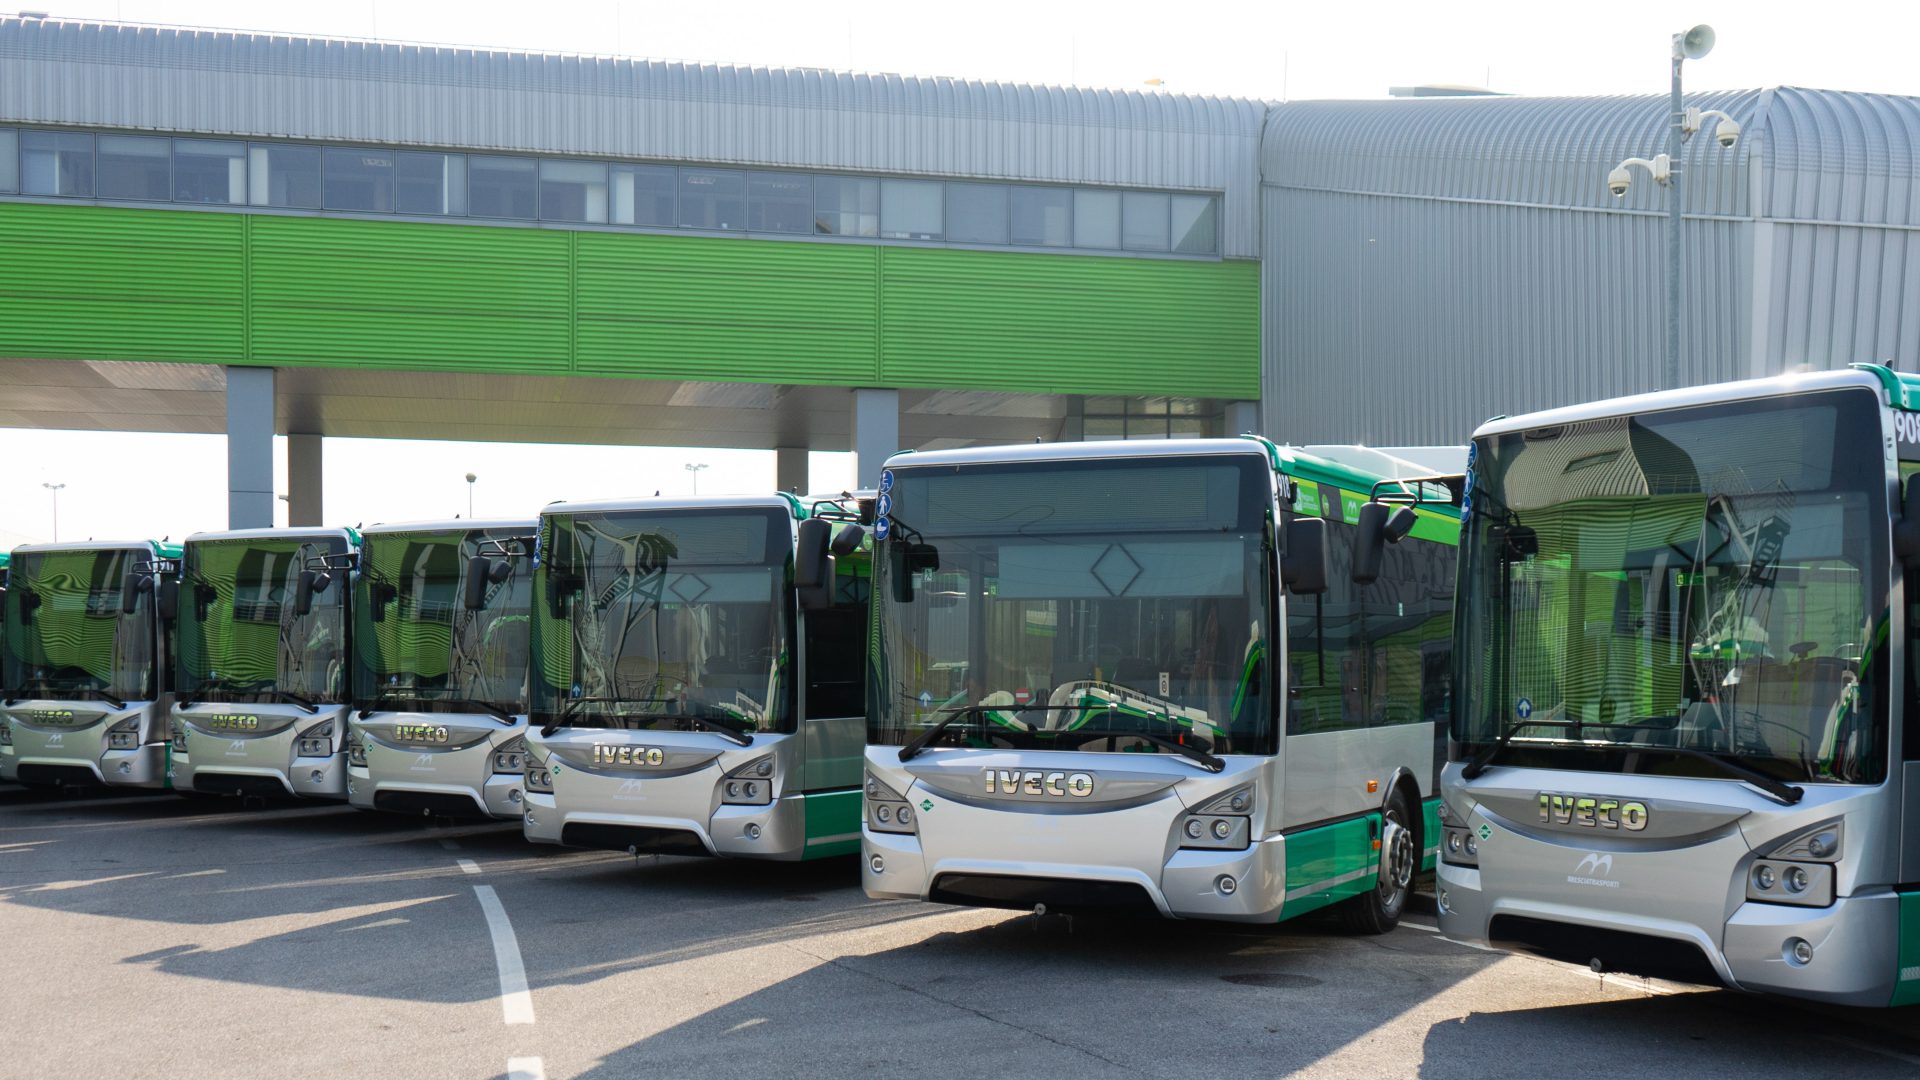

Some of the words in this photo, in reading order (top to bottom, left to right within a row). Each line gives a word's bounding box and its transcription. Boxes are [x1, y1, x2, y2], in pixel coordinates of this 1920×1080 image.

[33, 710, 74, 724] IVECO
[212, 714, 259, 729] IVECO
[395, 725, 449, 743] IVECO
[593, 744, 664, 766] IVECO
[985, 770, 1094, 797] IVECO
[1539, 794, 1648, 831] IVECO
